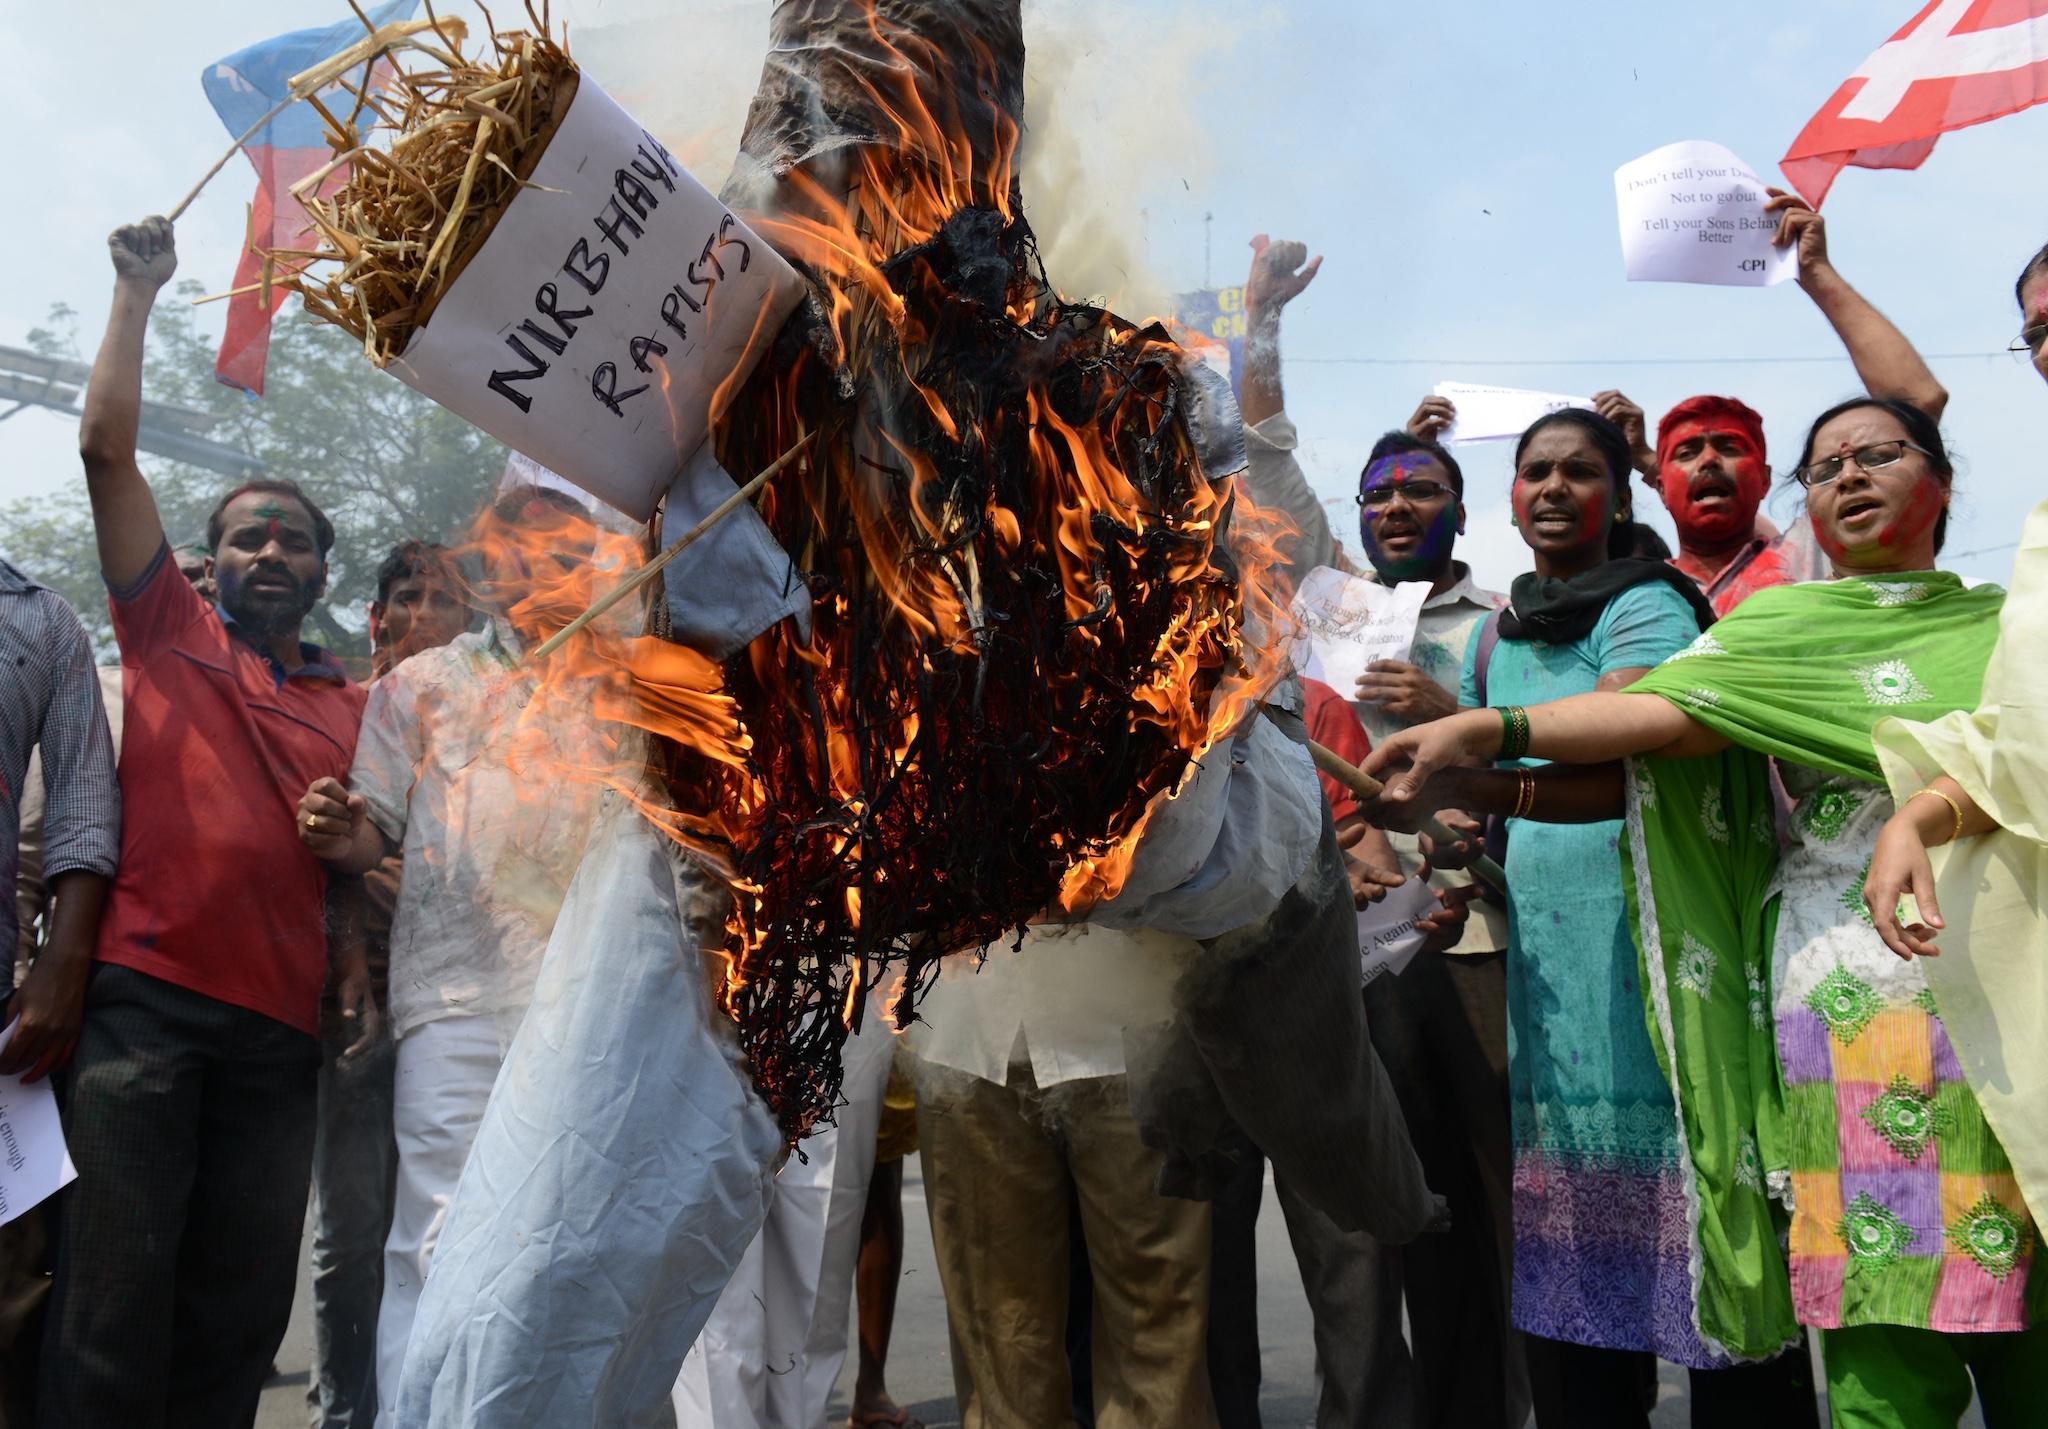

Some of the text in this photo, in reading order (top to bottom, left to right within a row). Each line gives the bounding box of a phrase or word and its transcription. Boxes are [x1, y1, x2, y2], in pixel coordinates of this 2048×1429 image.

[1628, 171, 1668, 191] Don't
[1672, 168, 1693, 182] tell
[1698, 168, 1727, 182] your
[1671, 192, 1757, 205] Not to go out
[1643, 219, 1669, 231] Tell
[1674, 220, 1702, 232] your
[1707, 217, 1735, 230] Sons
[1699, 230, 1733, 244] Better
[488, 129, 677, 413] NIRBHAYA
[1737, 260, 1766, 272] -CPI
[592, 214, 750, 418] RAPISTS
[0, 1122, 26, 1172] enough
